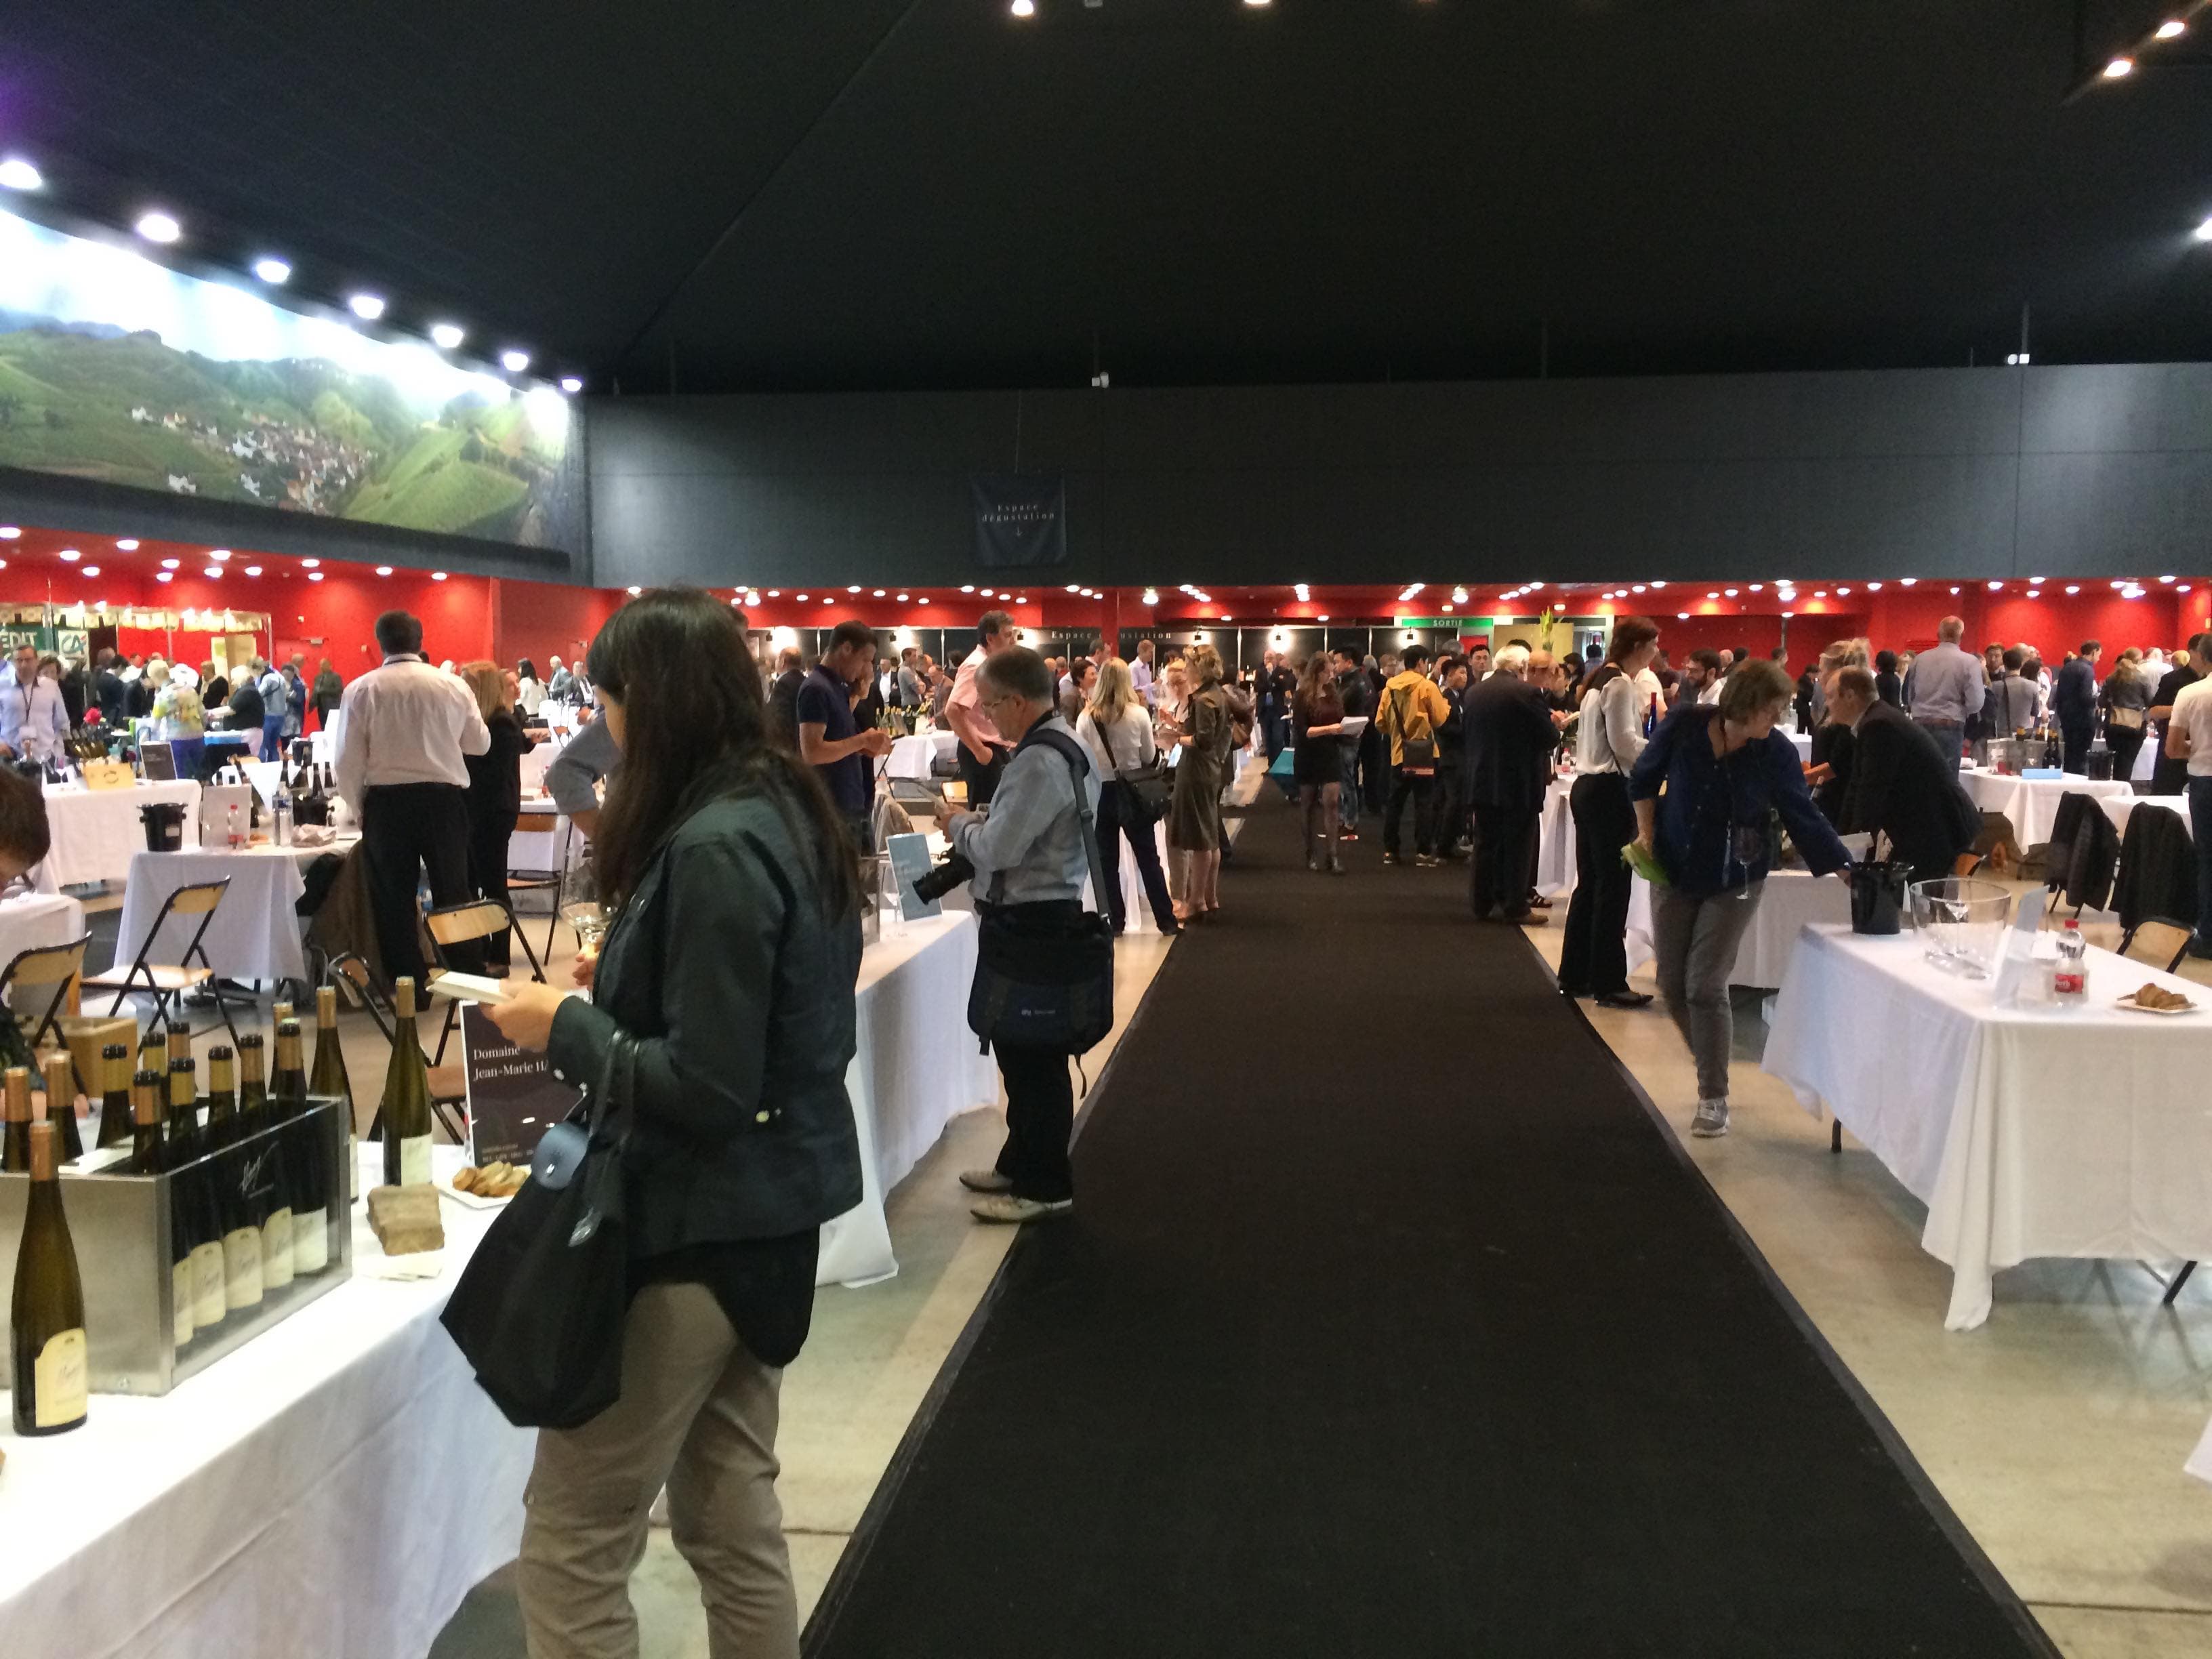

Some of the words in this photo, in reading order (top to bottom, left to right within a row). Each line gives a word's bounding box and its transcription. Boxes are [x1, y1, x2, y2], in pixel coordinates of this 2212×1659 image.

[998, 504, 1038, 512] Espace
[1052, 630, 1092, 640] Espace
[474, 1045, 520, 1061] Domaine
[473, 1061, 533, 1082] Jean-Marie
